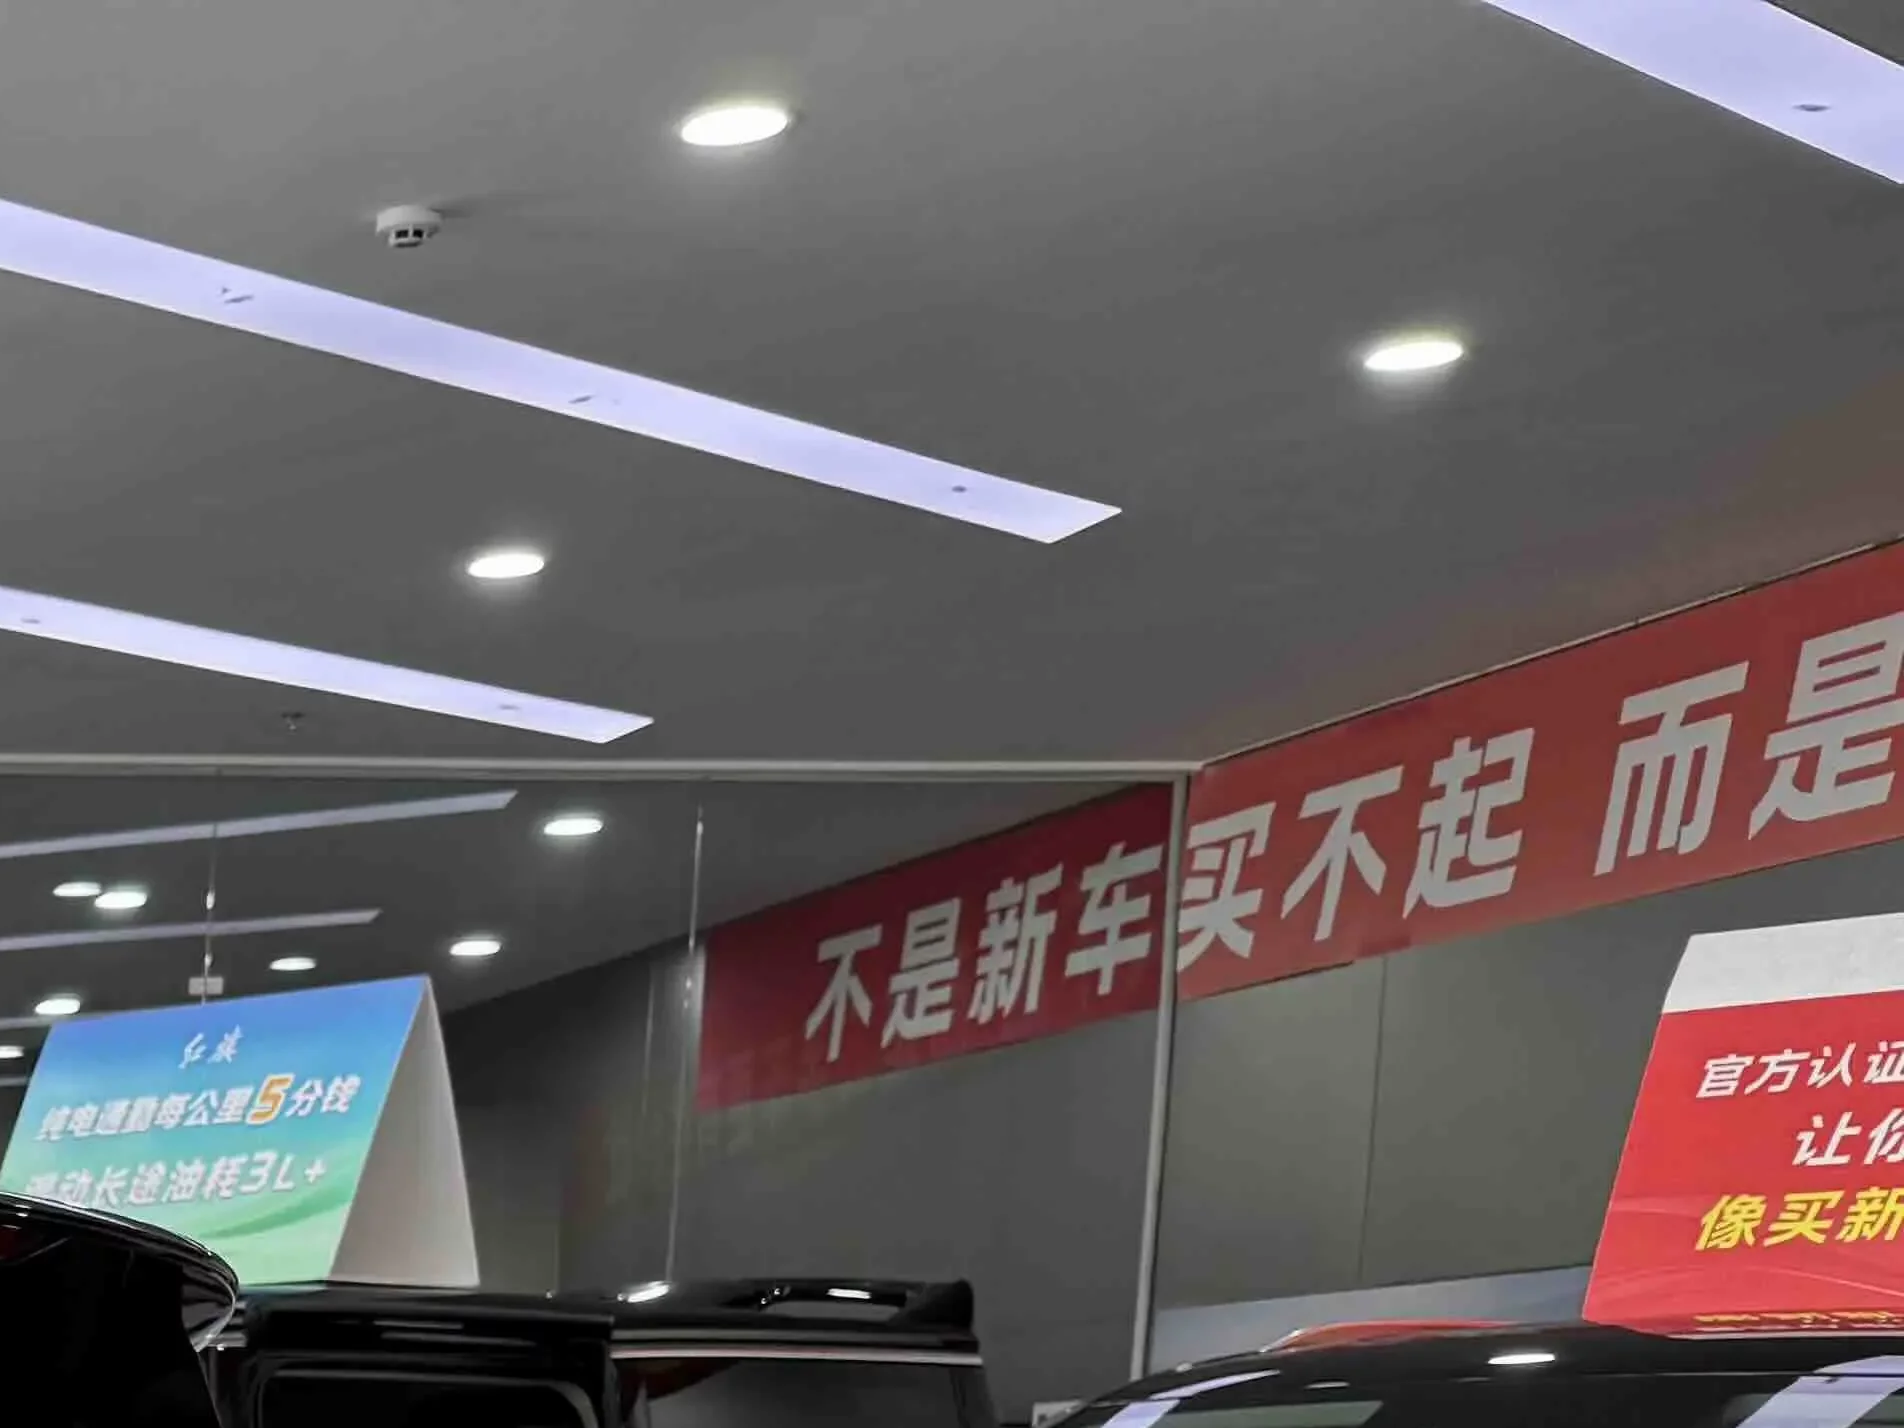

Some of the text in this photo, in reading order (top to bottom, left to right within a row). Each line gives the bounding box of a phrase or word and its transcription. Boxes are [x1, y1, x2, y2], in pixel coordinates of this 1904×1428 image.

[804, 610, 1904, 1063] 不是新车买不起 而是
[1695, 1041, 1904, 1100] 官方认证
[1695, 1186, 1904, 1252] 像买新
